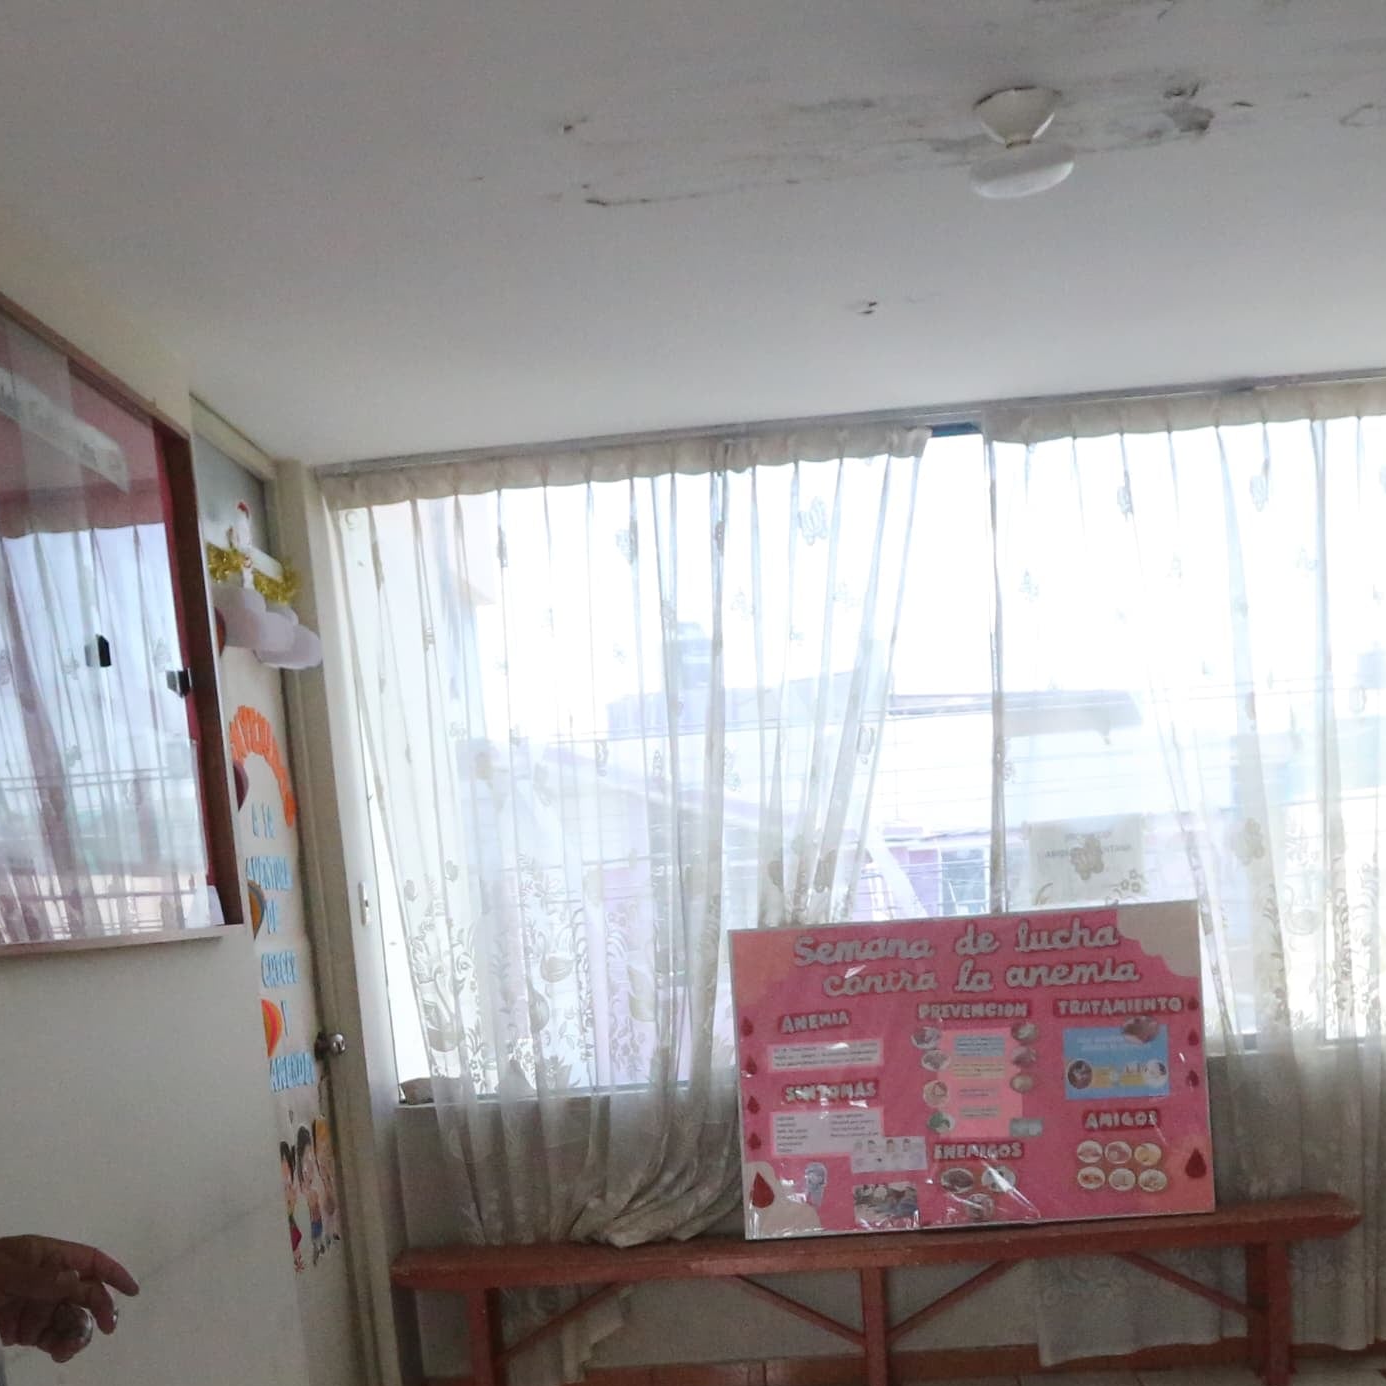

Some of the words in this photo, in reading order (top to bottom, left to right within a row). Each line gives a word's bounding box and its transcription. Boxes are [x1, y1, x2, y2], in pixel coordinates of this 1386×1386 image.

[794, 934, 935, 967] Semana
[955, 921, 999, 956] de
[1014, 917, 1119, 953] lucha
[823, 966, 938, 998] contra
[954, 958, 994, 993] la
[1005, 957, 1140, 988] anemia
[918, 1001, 1028, 1019] PREVENCION
[1057, 997, 1183, 1015] TRATAMIENTO
[780, 1010, 850, 1034] ANEMIA
[784, 1081, 877, 1102] SINTOMAS
[1085, 1110, 1158, 1129] AMIGOS
[933, 1142, 1023, 1160] ENEMIGOS
